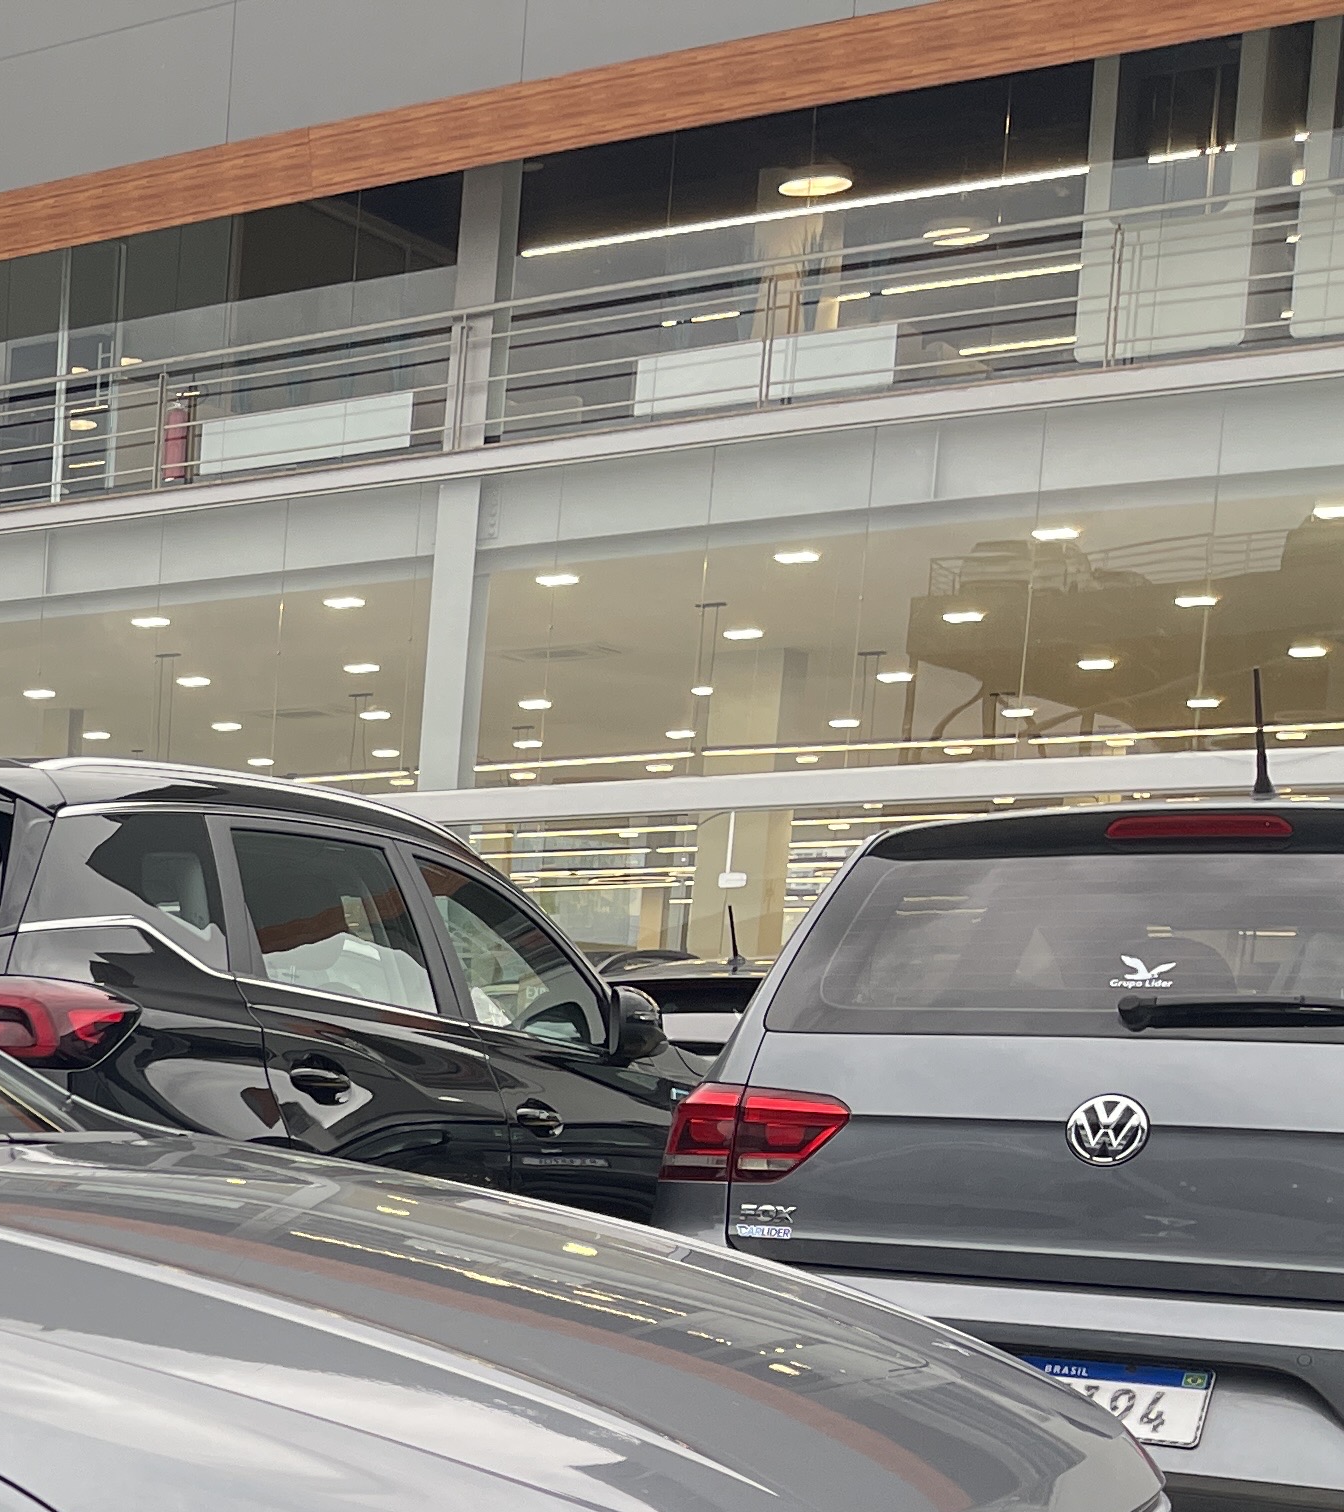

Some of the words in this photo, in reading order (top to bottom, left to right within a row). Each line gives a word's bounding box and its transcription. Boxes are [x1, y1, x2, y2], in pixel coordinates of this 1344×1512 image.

[1109, 979, 1143, 989] Grupo
[740, 1204, 797, 1223] FOX
[738, 1225, 791, 1238] CARLIDER
[1044, 1364, 1088, 1377] BRASIL
